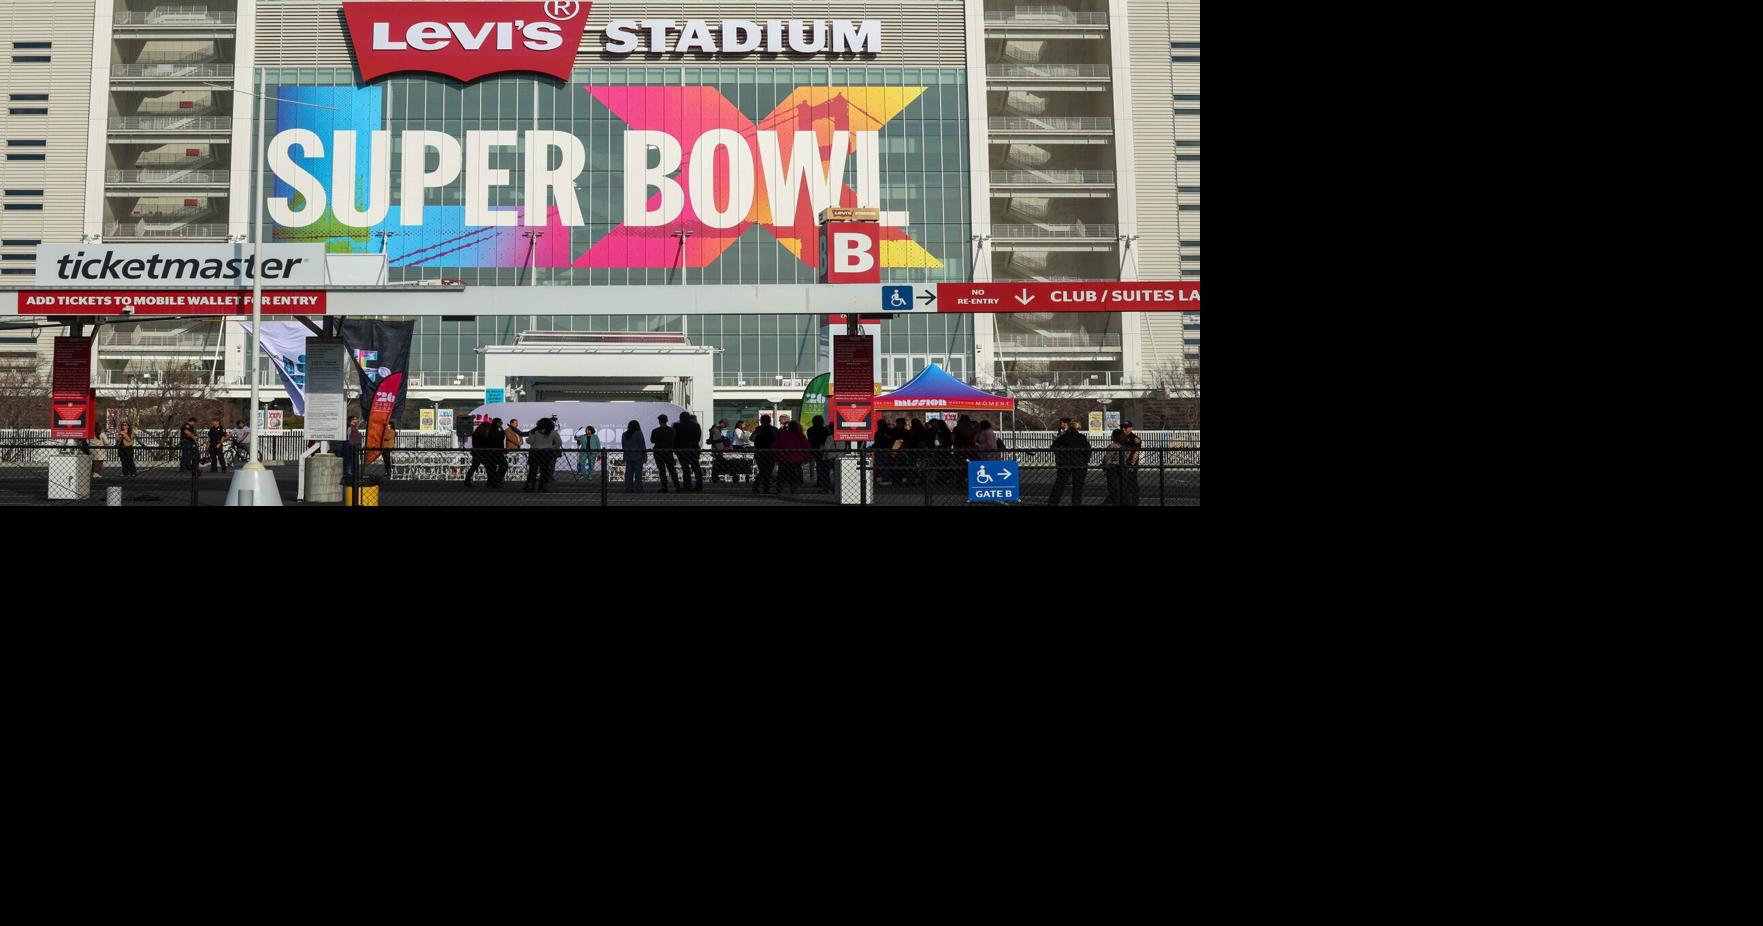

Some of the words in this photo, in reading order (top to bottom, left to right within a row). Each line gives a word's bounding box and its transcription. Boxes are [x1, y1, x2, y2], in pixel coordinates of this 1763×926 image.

[605, 19, 882, 53] STADIUM
[267, 128, 586, 227] SUPER
[623, 128, 909, 228] BOWL
[57, 250, 302, 280] ticketmaster
[833, 232, 875, 272] B
[26, 296, 55, 305] ADD
[57, 296, 112, 305] TICKETS
[113, 296, 131, 305] TO
[133, 296, 185, 305] MOBILE
[187, 296, 241, 305] WALLET
[243, 296, 270, 305] FR
[273, 296, 318, 305] ENTRY
[1050, 290, 1098, 302] CLUB
[1111, 290, 1175, 302] SUITES
[975, 490, 1004, 498] GATE
[1005, 490, 1013, 498] B
